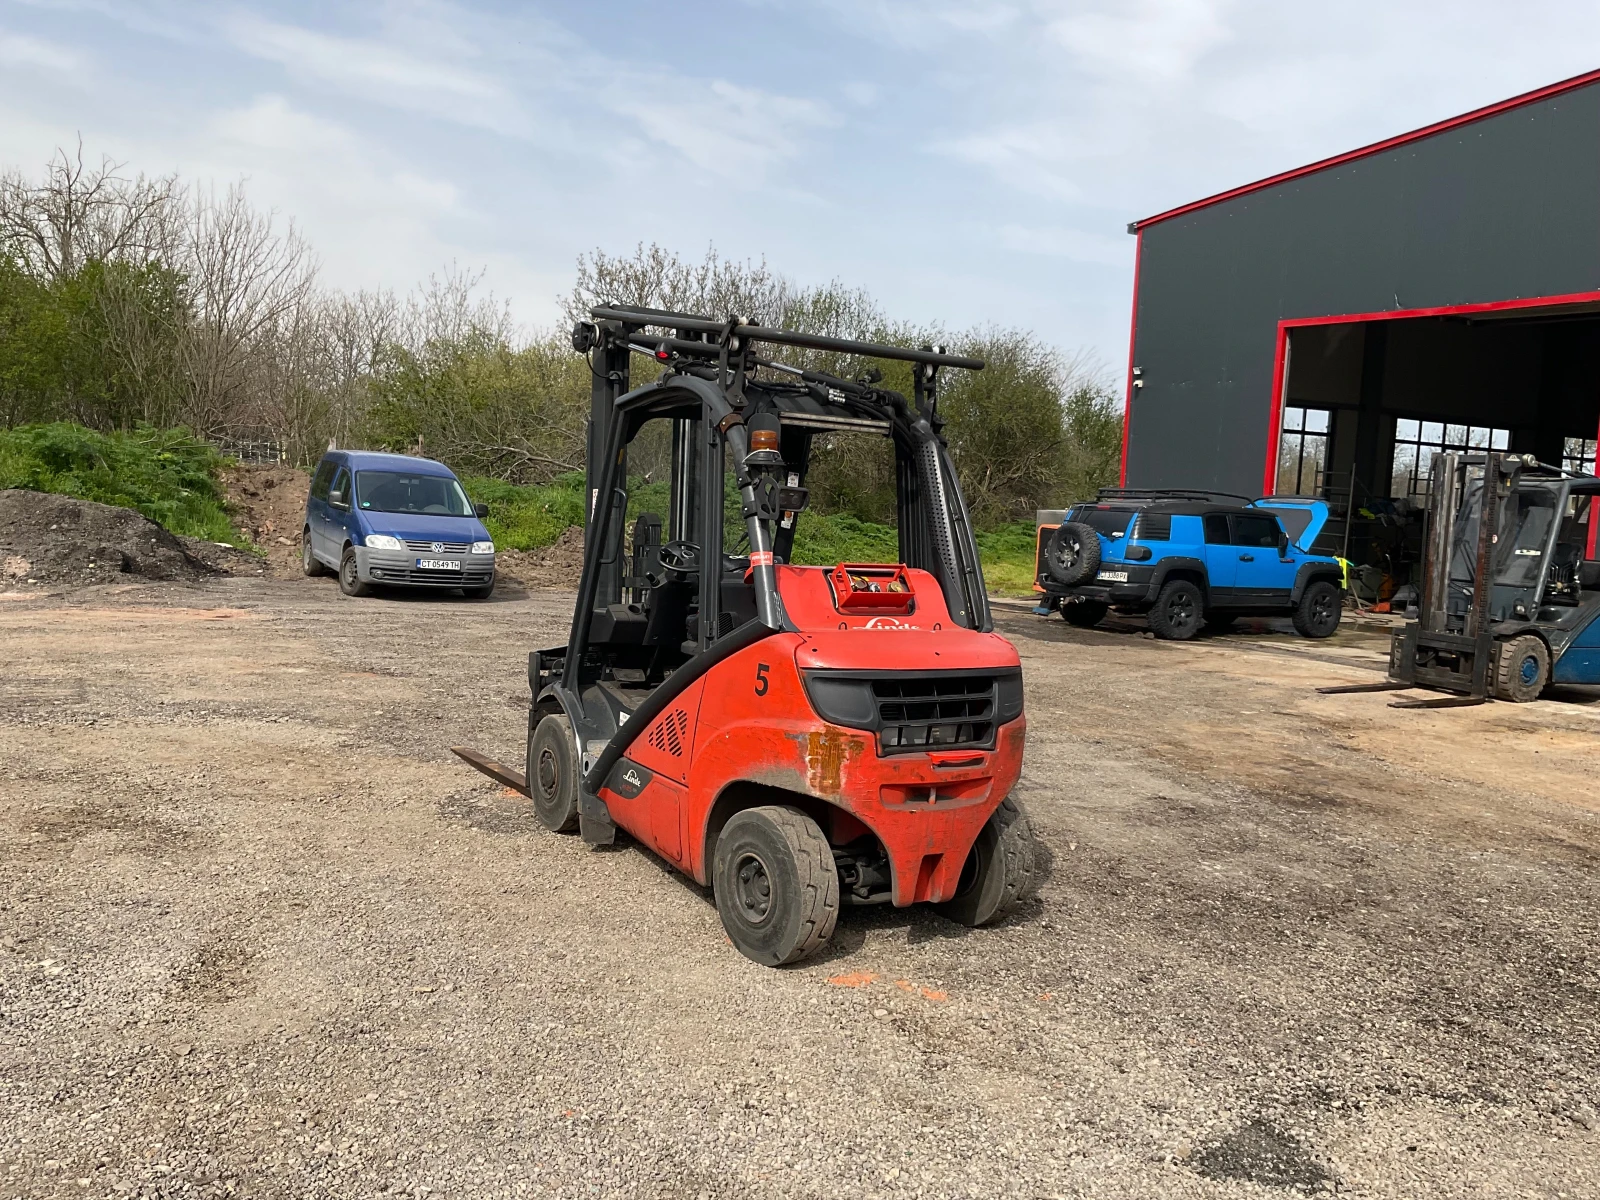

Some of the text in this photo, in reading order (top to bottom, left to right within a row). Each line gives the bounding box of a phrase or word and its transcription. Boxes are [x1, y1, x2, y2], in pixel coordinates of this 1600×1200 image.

[421, 560, 431, 568] CT
[450, 561, 460, 569] TH
[852, 616, 920, 631] Linde
[754, 662, 770, 697] 5
[622, 769, 641, 787] Linde
